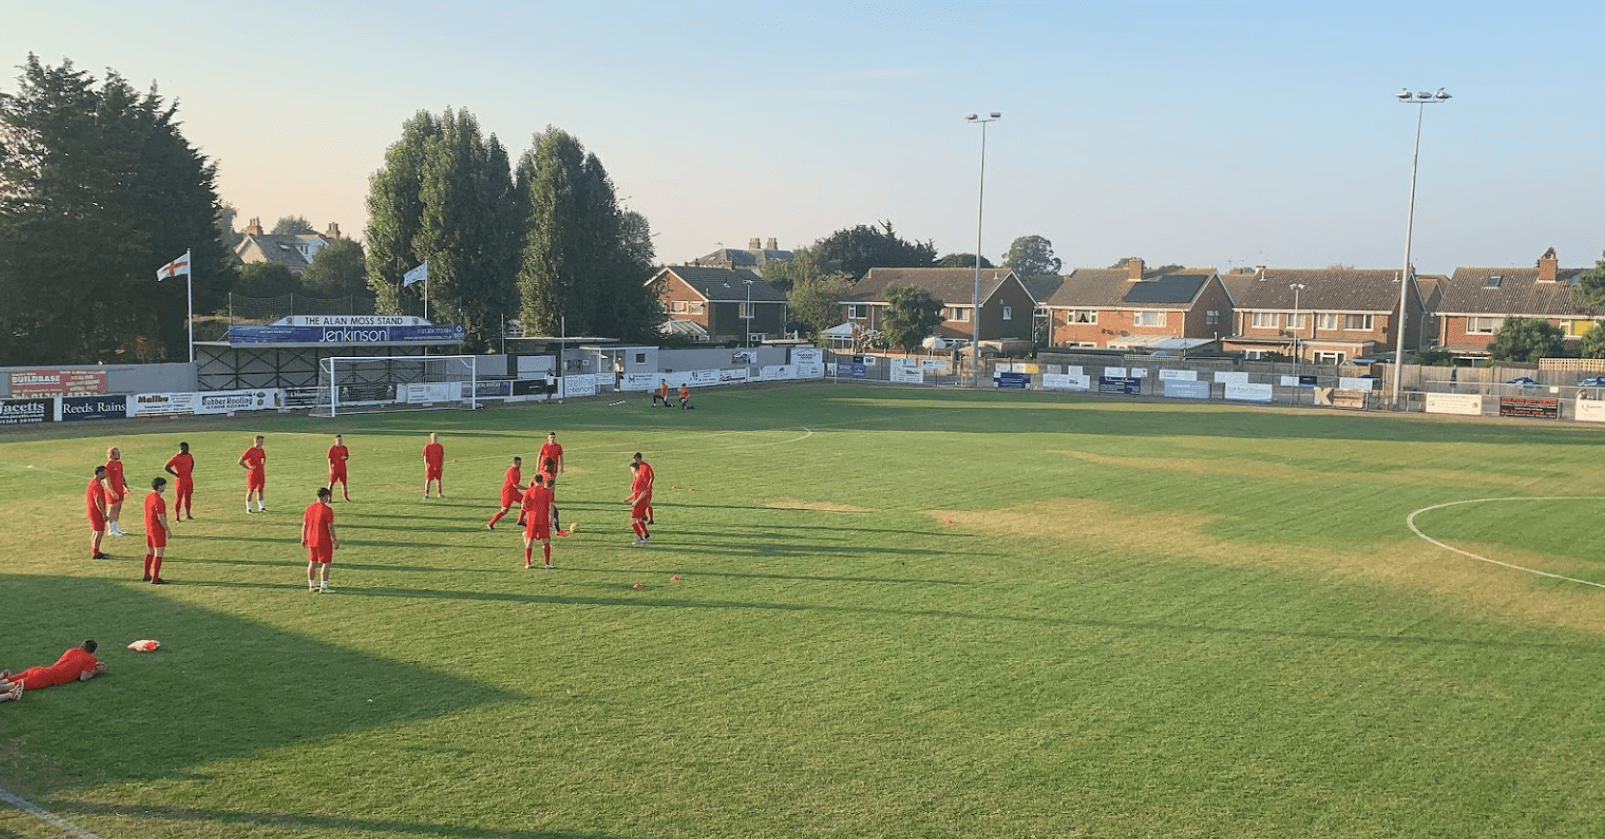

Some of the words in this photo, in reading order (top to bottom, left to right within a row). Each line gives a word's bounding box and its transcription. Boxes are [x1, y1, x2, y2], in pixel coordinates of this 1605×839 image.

[305, 317, 320, 325] THE
[323, 317, 347, 325] ALAN
[350, 317, 374, 325] MOSS
[377, 317, 403, 325] STAND
[319, 327, 387, 342] Jenkinson
[12, 375, 60, 383] BUILDBASE
[63, 403, 93, 414] Reeds
[97, 401, 126, 412] Rains
